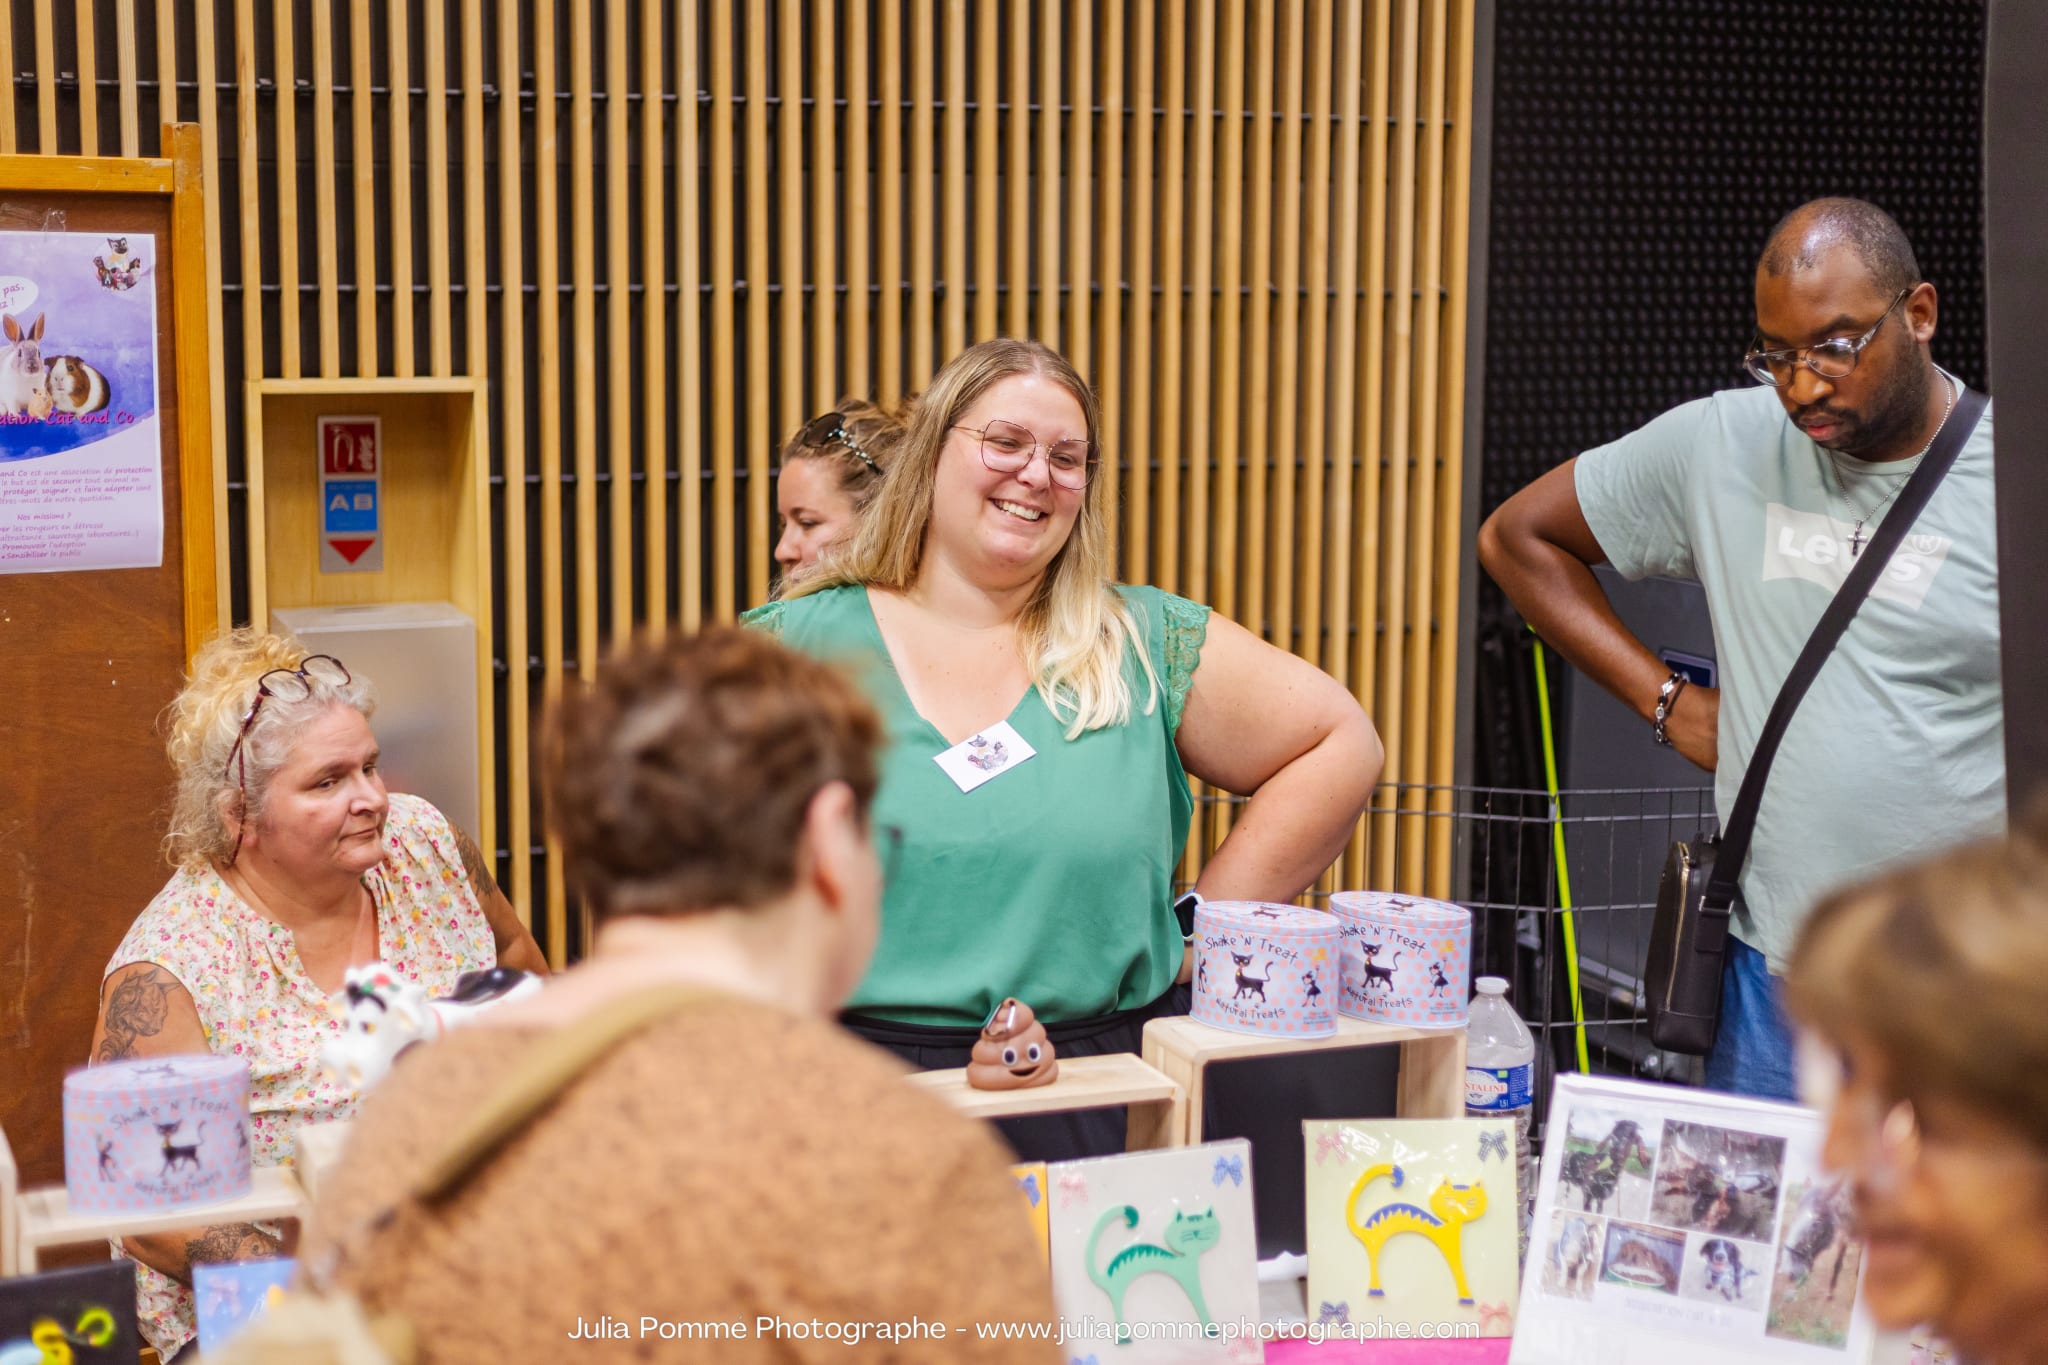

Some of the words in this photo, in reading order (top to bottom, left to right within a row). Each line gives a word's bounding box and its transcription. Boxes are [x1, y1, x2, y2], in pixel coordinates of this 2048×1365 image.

[45, 409, 74, 425] Cat
[80, 408, 110, 425] and
[115, 409, 135, 425] Co
[17, 469, 28, 477] Co
[44, 469, 58, 477] une
[61, 467, 100, 477] association
[103, 466, 113, 474] de
[115, 465, 153, 475] protection
[40, 477, 50, 486] de
[52, 477, 83, 485] secourir
[103, 475, 129, 484] animal
[84, 485, 102, 493] faire
[104, 483, 134, 493] adopter
[17, 513, 31, 521] Nos
[33, 512, 65, 520] missions
[6, 550, 48, 559] Sensibiliser
[1388, 928, 1427, 955] Treat
[1205, 934, 1238, 950] Shake
[1261, 938, 1299, 965] Treat
[1346, 985, 1377, 1007] Natural
[1378, 997, 1414, 1009] Treats
[1215, 997, 1248, 1019] Natural
[1250, 1007, 1287, 1020] Treats
